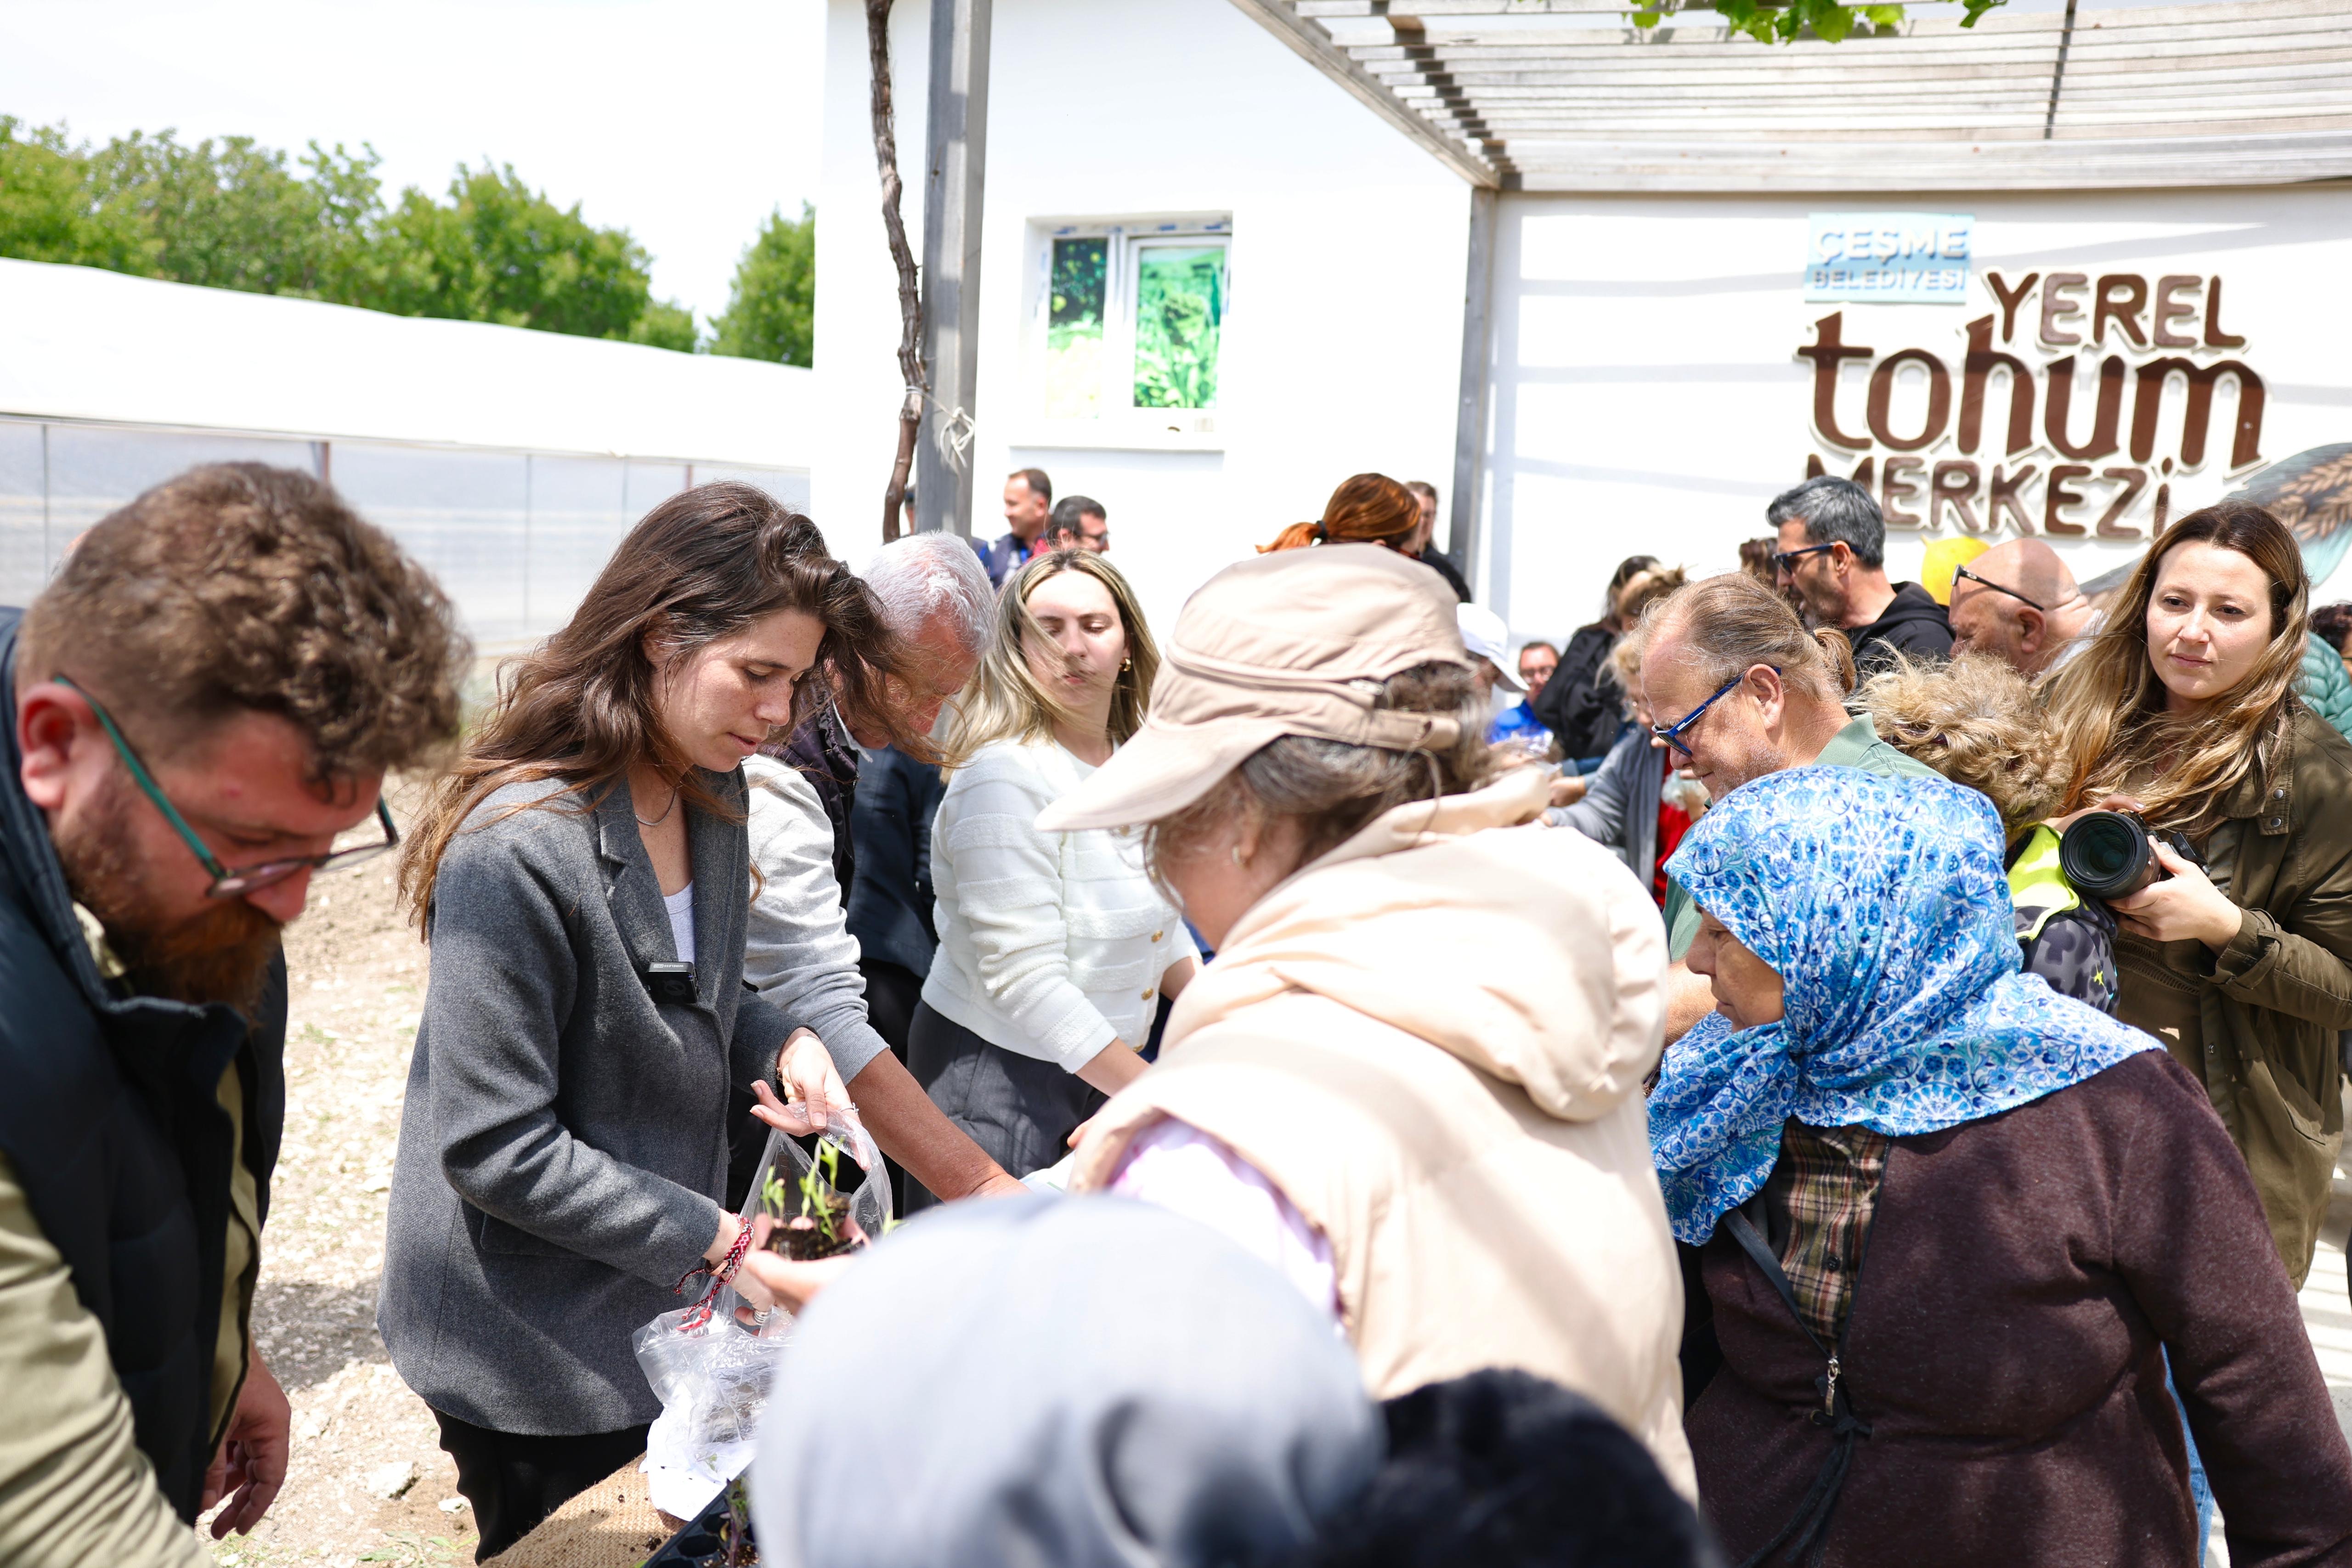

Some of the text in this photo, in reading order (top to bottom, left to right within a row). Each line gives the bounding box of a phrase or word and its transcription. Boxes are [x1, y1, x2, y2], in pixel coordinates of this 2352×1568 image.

[1815, 229, 1968, 266] ÇEŞME
[1813, 267, 1965, 290] BELEDİYESİ
[1987, 272, 2246, 348] YEREL
[1797, 310, 2267, 469] tohum
